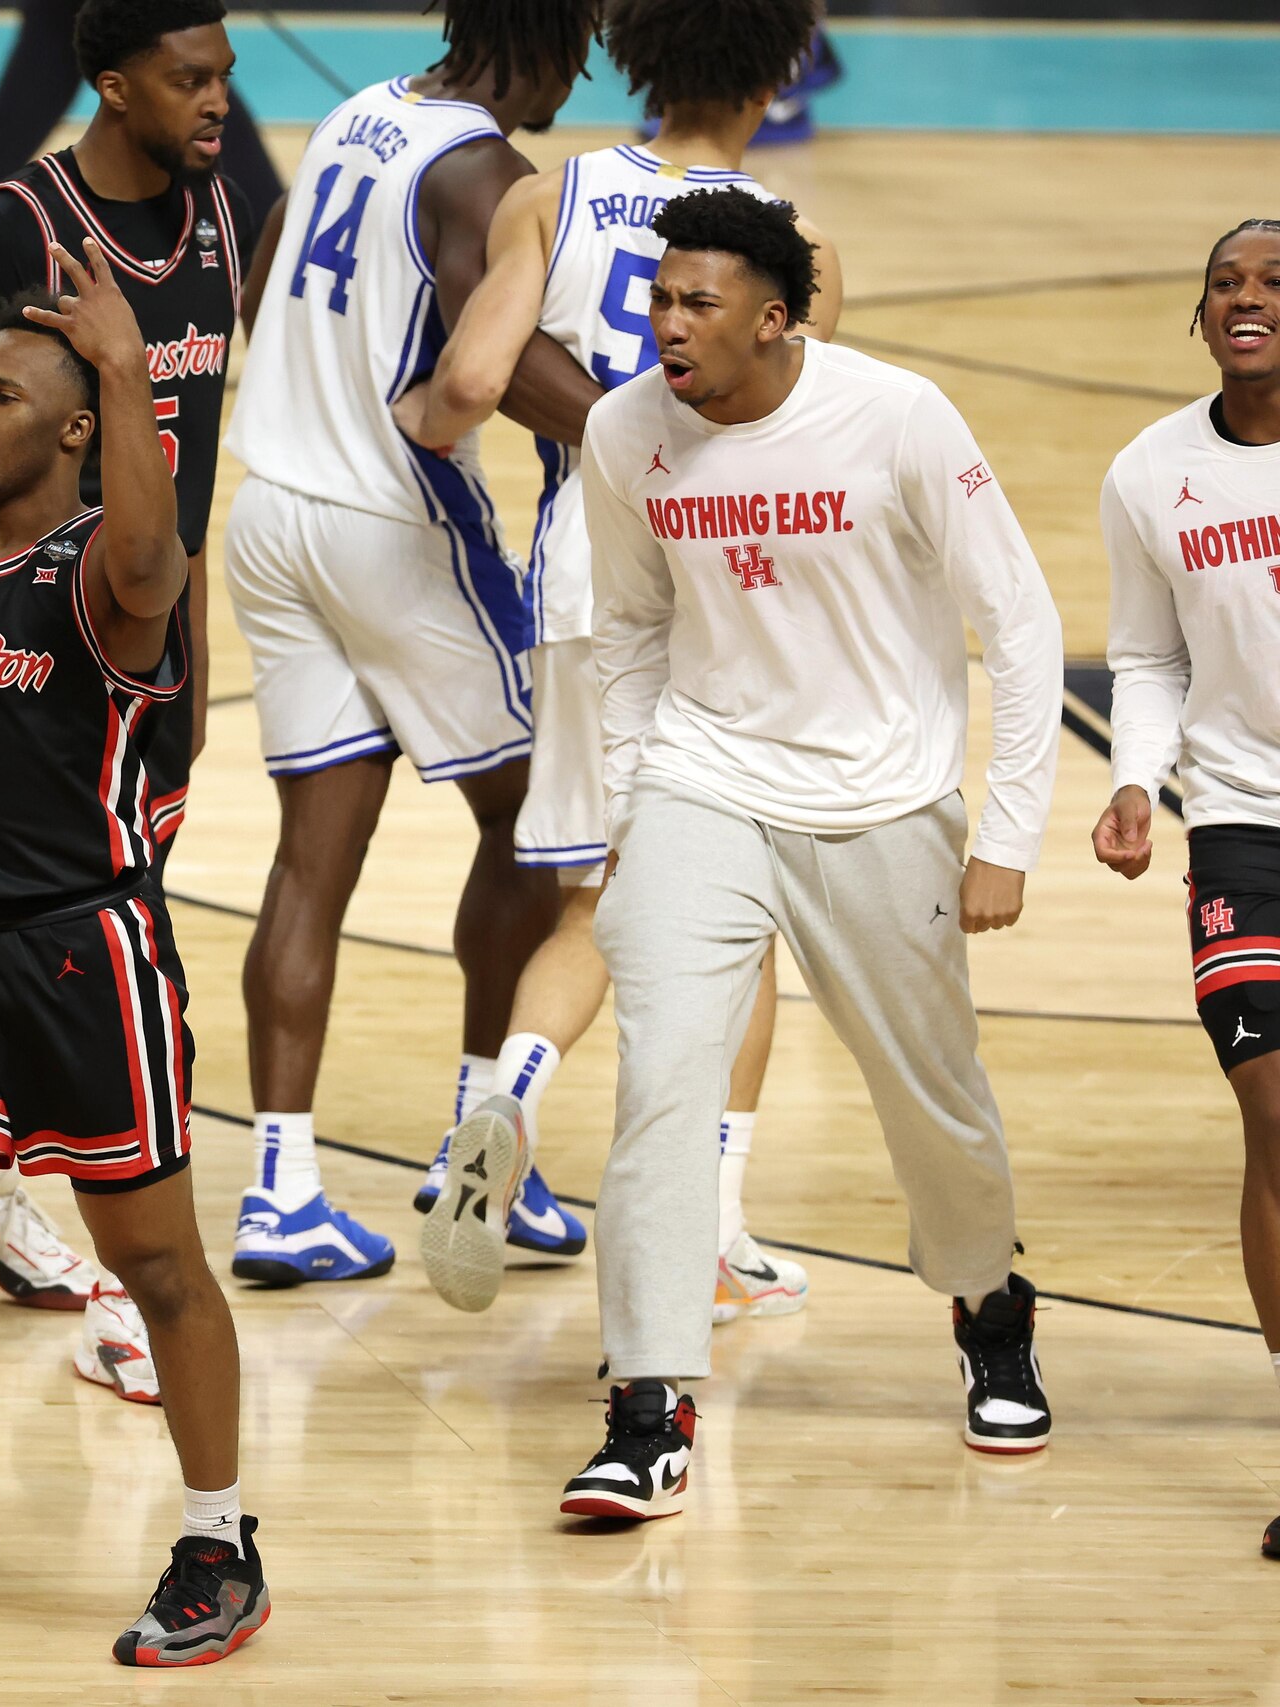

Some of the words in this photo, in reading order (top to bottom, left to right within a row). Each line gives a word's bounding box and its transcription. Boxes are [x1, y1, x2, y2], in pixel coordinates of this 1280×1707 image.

[337, 114, 408, 164] JAMES
[589, 193, 668, 231] PROC
[289, 163, 377, 316] 14
[145, 322, 227, 383] uston
[646, 493, 770, 540] NOTHING
[775, 490, 854, 535] EASY.
[1178, 515, 1280, 572] NOTHIN
